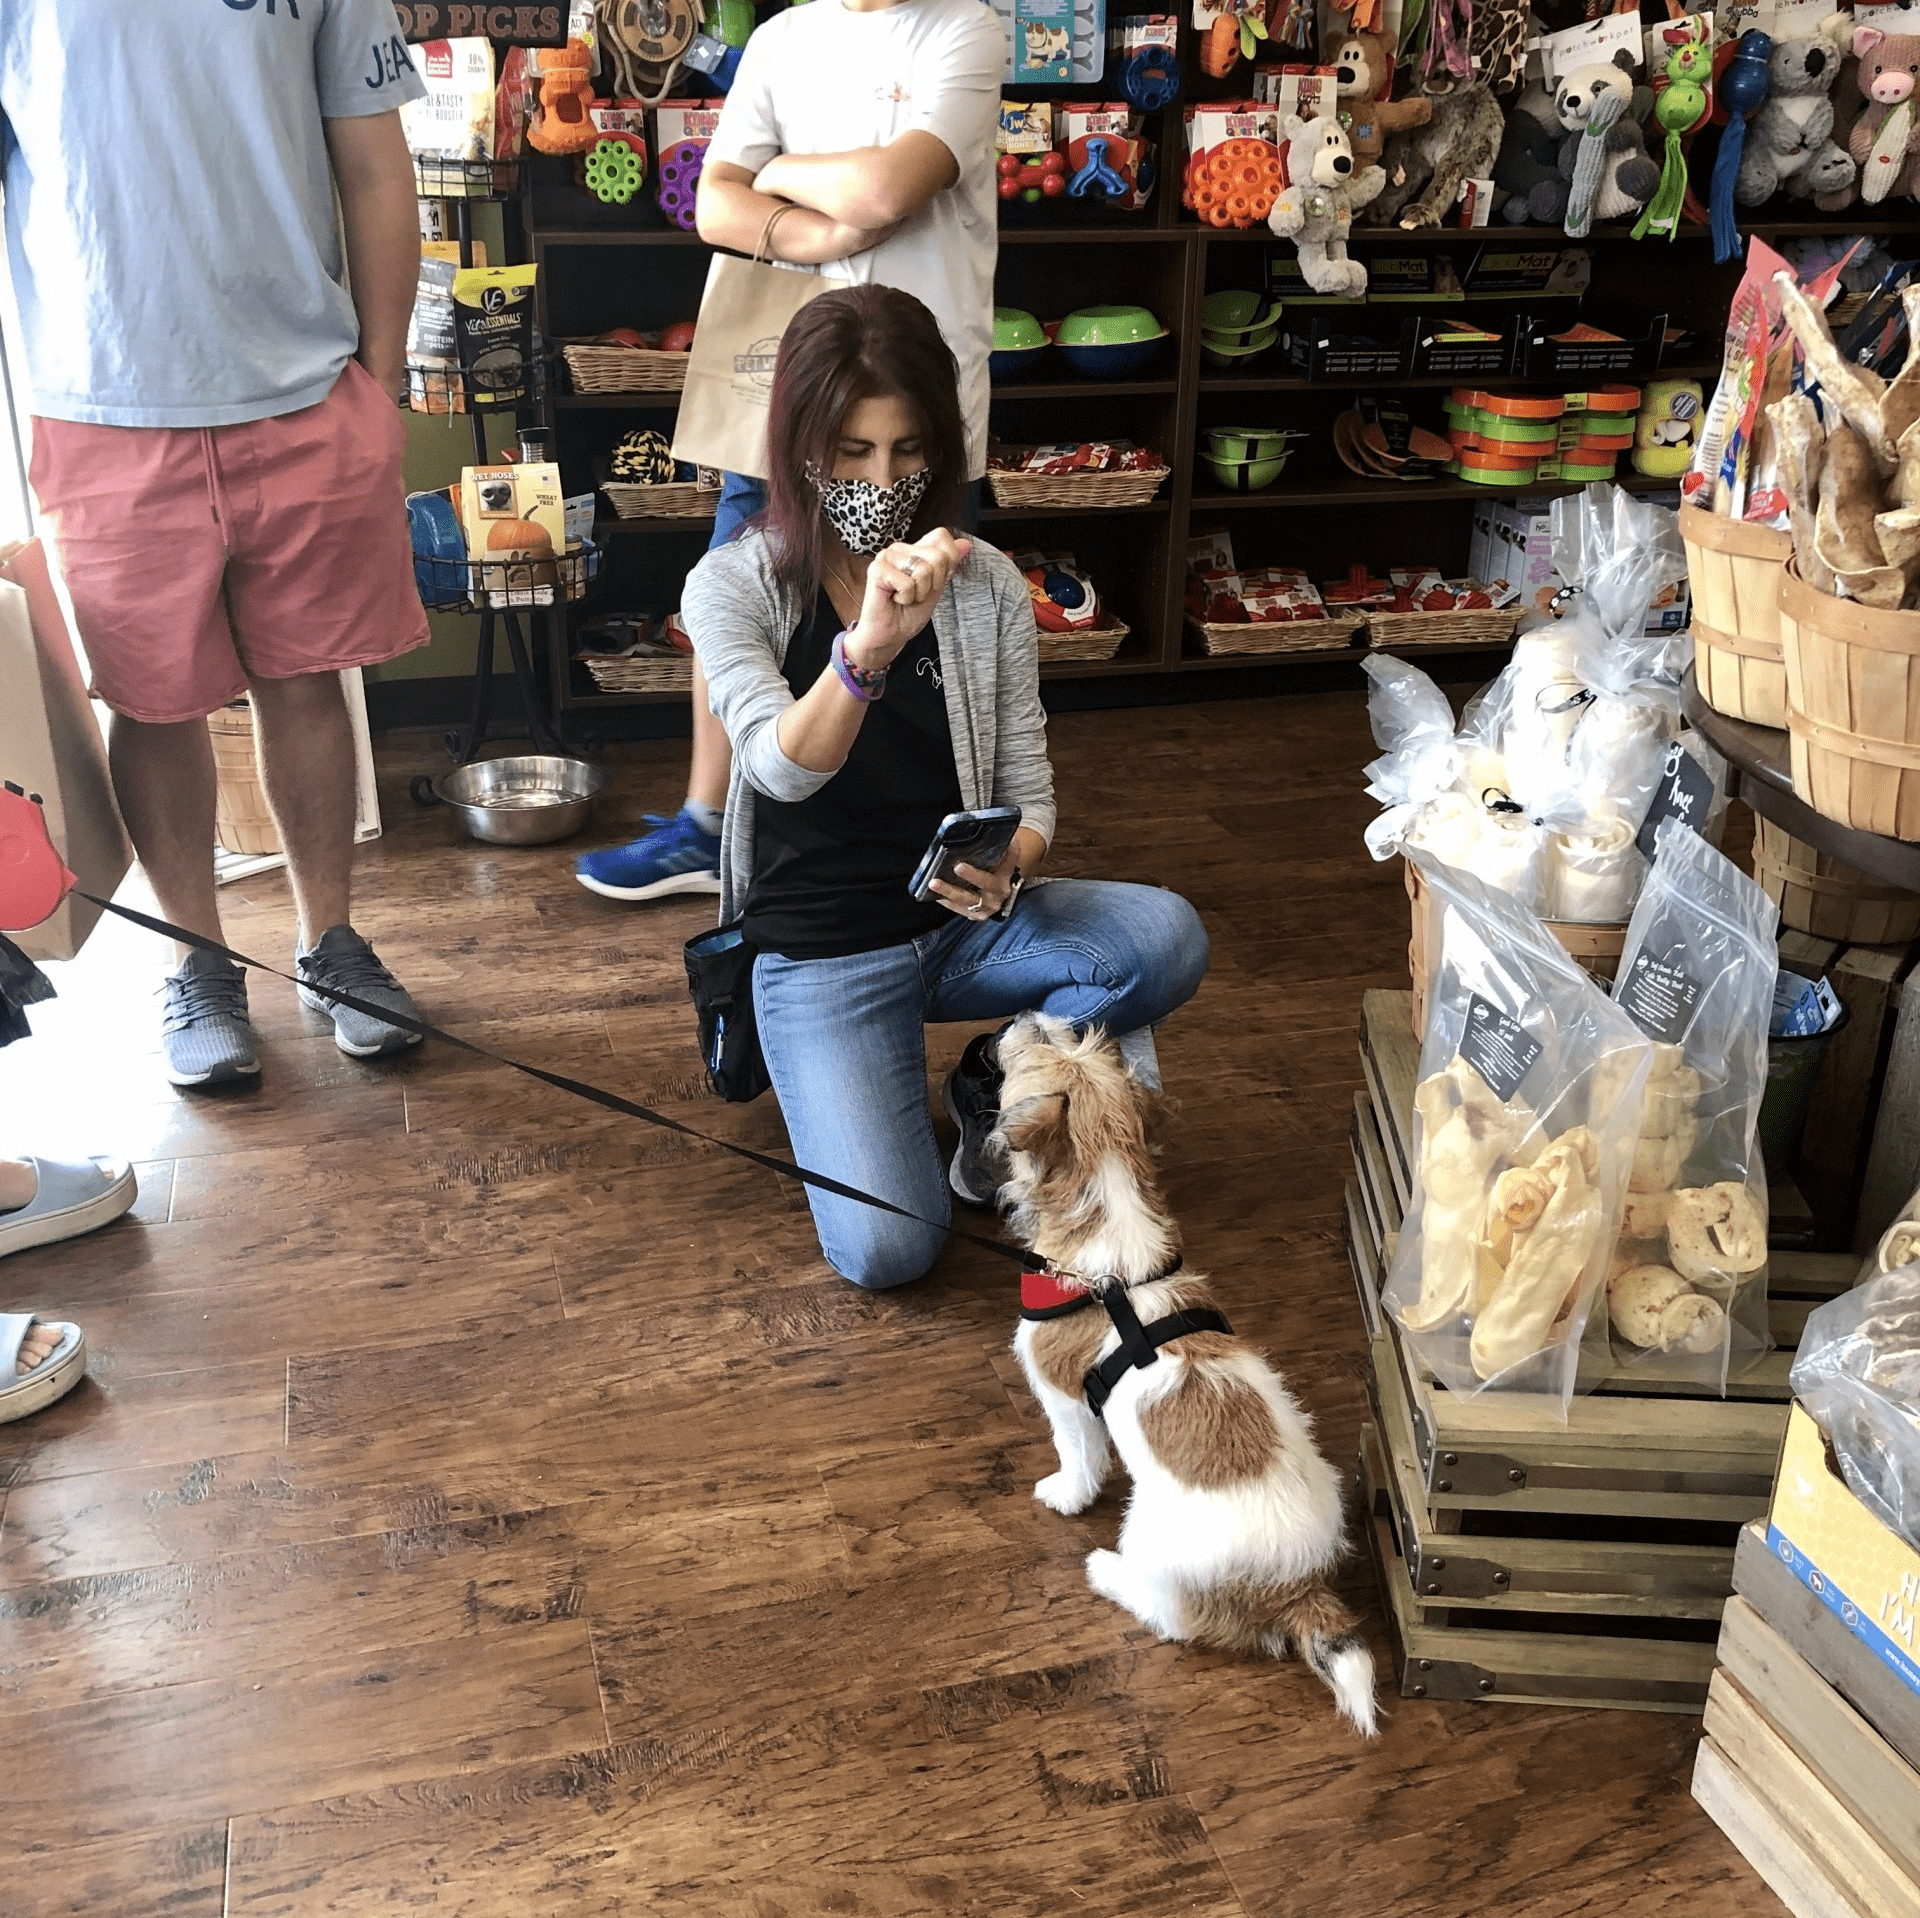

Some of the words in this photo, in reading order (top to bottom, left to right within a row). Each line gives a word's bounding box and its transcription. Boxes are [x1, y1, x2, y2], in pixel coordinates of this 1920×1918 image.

[400, 5, 438, 37] OP
[449, 5, 560, 38] PICKS
[1298, 77, 1322, 92] KONG
[1087, 115, 1111, 125] KONG
[1225, 115, 1257, 128] KONG
[470, 473, 489, 481] WET
[491, 471, 519, 480] NOSES
[1885, 1646, 1920, 1688] www.honey
